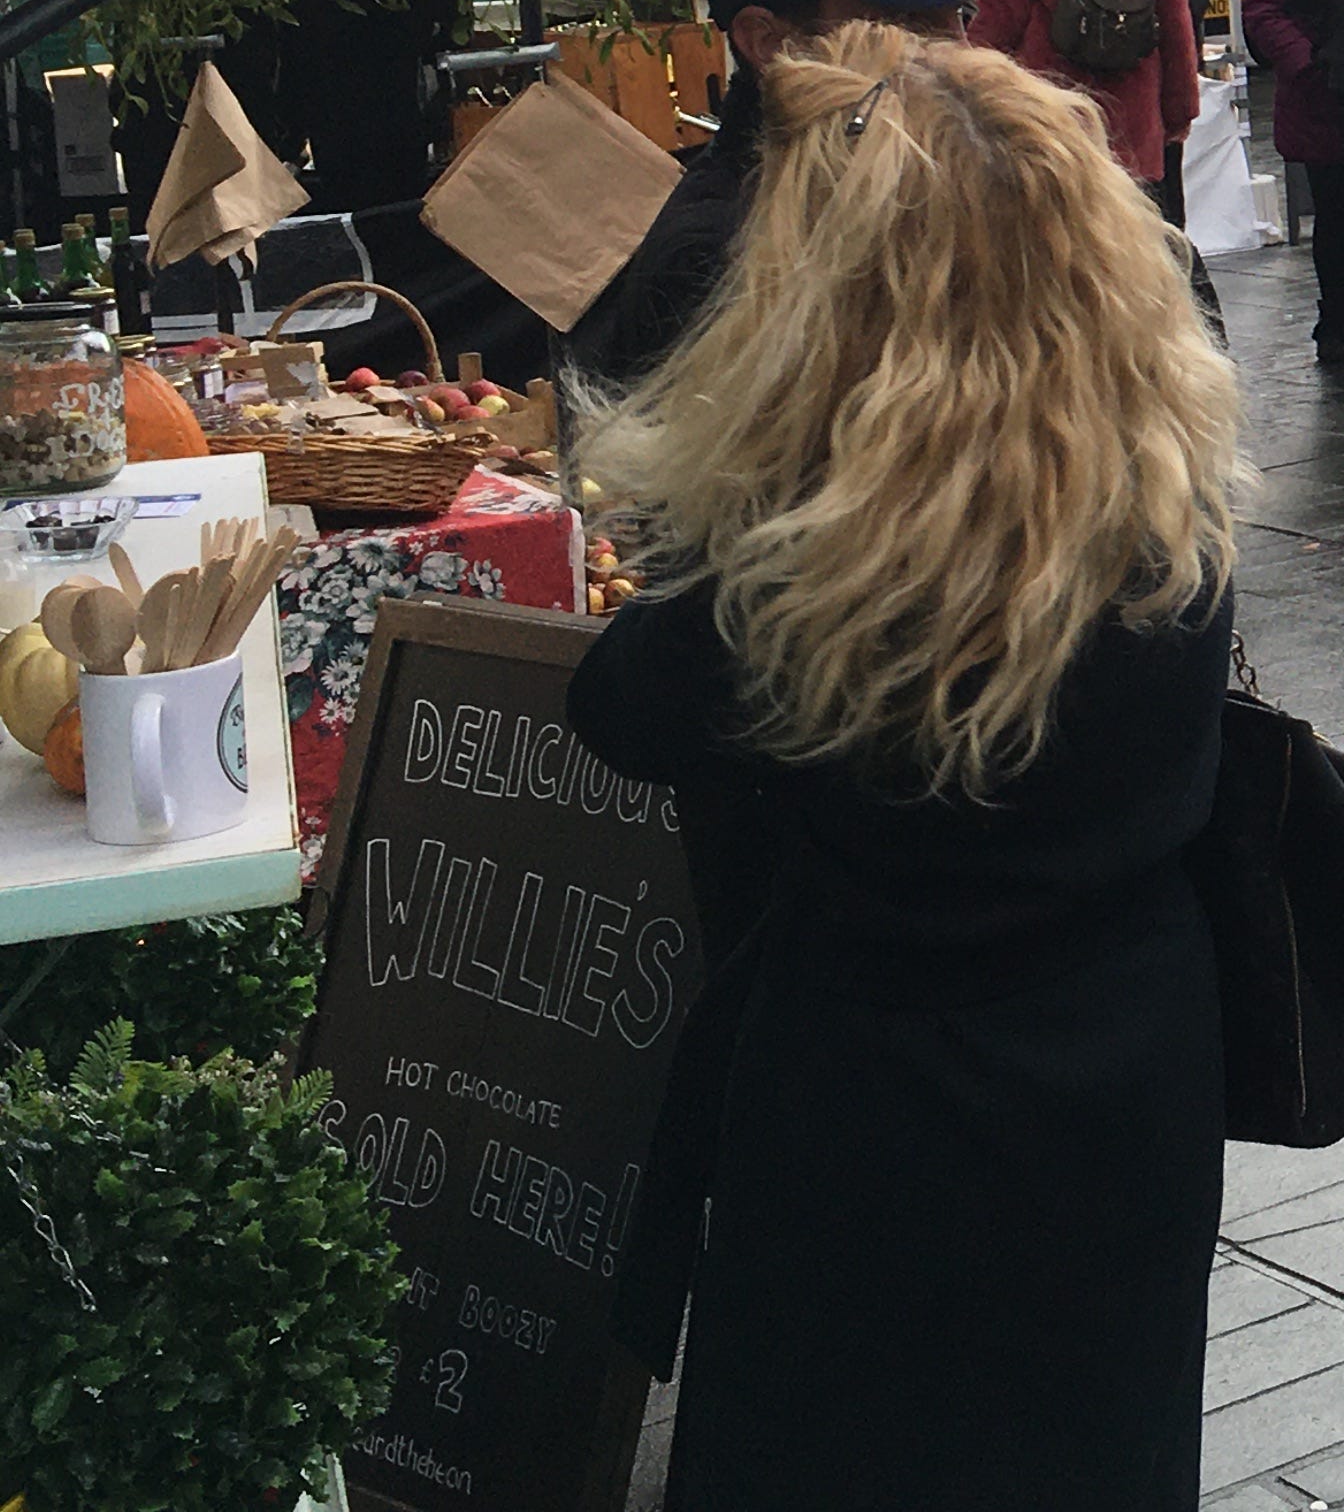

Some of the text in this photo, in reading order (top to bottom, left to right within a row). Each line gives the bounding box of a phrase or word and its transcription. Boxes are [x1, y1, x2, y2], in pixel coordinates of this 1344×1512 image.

[366, 838, 685, 1050] WILLIE'S
[386, 1056, 563, 1129] HOT CHOCOLATE
[470, 1139, 641, 1277] HERE!
[459, 1284, 558, 1355] BOOZY
